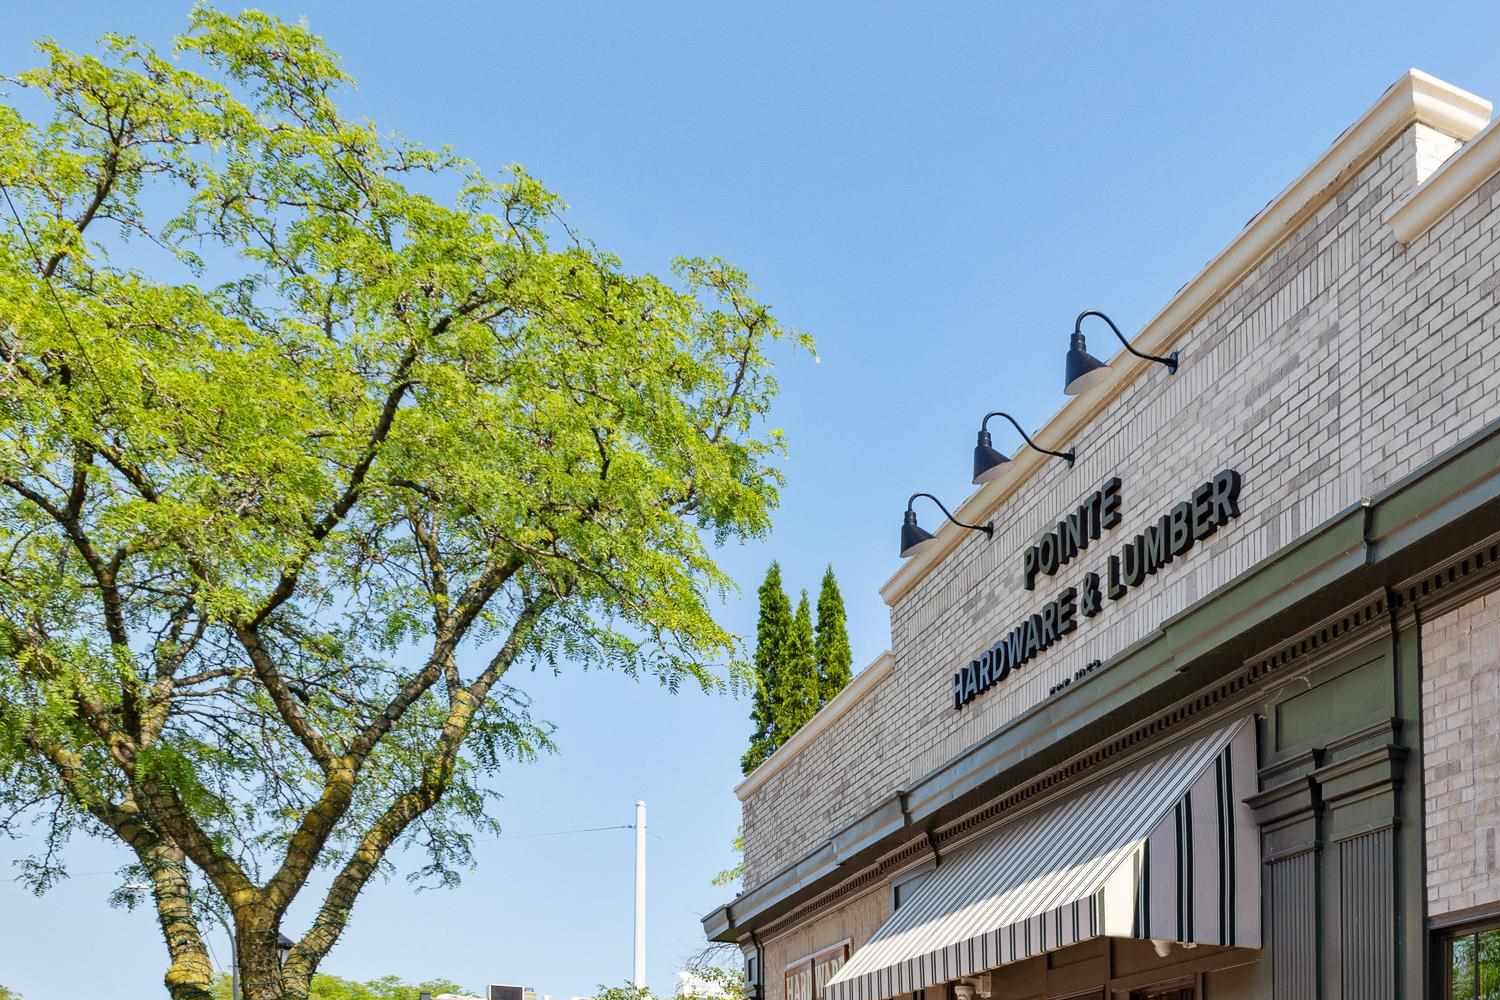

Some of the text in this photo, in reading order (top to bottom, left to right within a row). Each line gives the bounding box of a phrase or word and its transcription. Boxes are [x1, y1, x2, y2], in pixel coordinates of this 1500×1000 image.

[952, 469, 1241, 710] HARDWARE & LUMBER
[1024, 477, 1122, 590] POINTE
